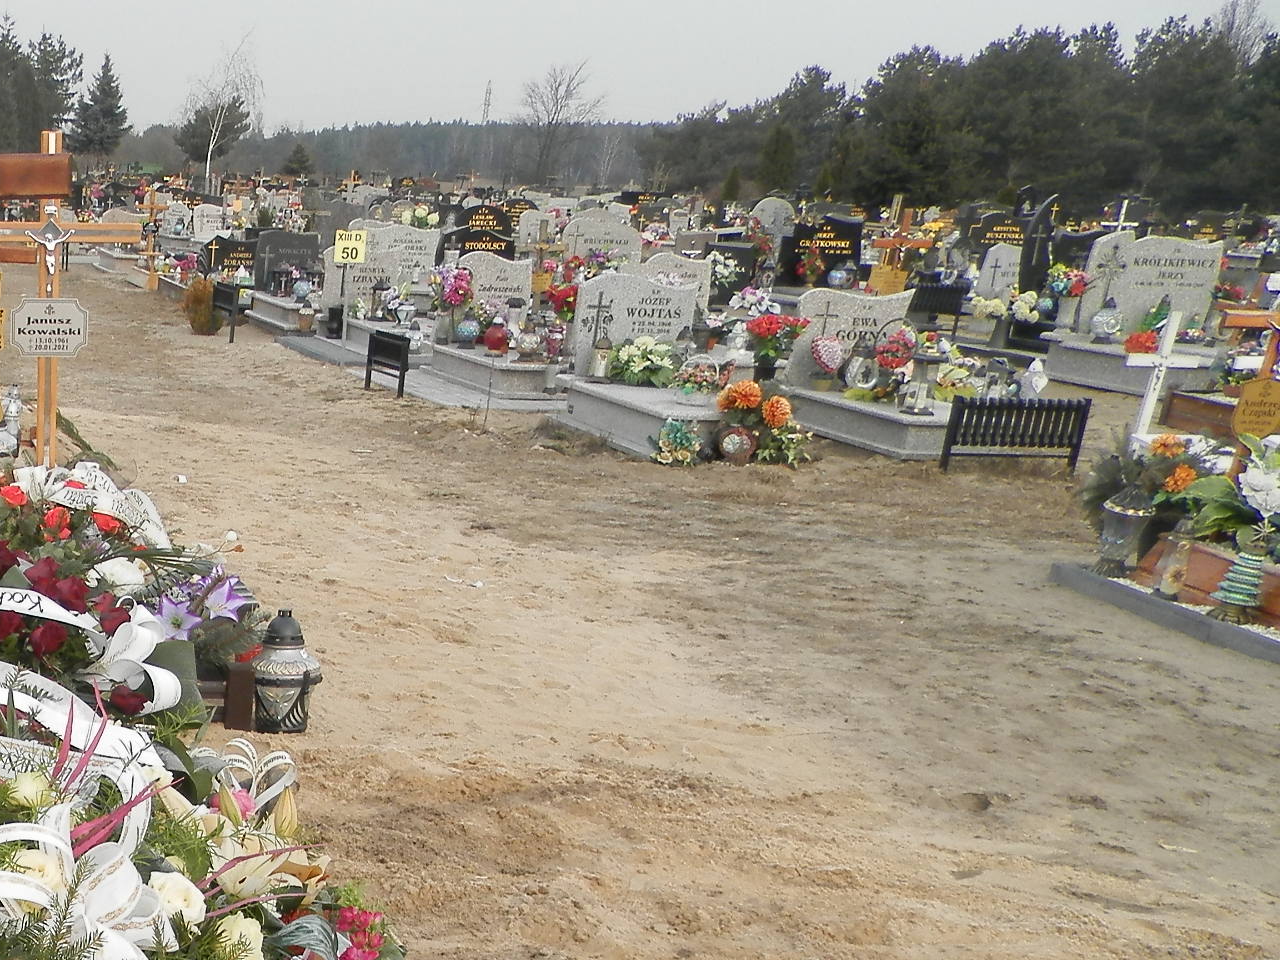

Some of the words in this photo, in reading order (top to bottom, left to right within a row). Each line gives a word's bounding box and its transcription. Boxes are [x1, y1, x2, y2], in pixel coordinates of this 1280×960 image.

[337, 233, 353, 241] XIII
[355, 233, 362, 241] D
[464, 242, 507, 250] STODOLSCY
[341, 247, 359, 260] 50
[639, 294, 672, 306] JÓZEF
[626, 305, 682, 319] WOJTAŚ
[26, 316, 72, 326] Janusz
[852, 317, 878, 327] EWA
[17, 327, 81, 336] Kowalski
